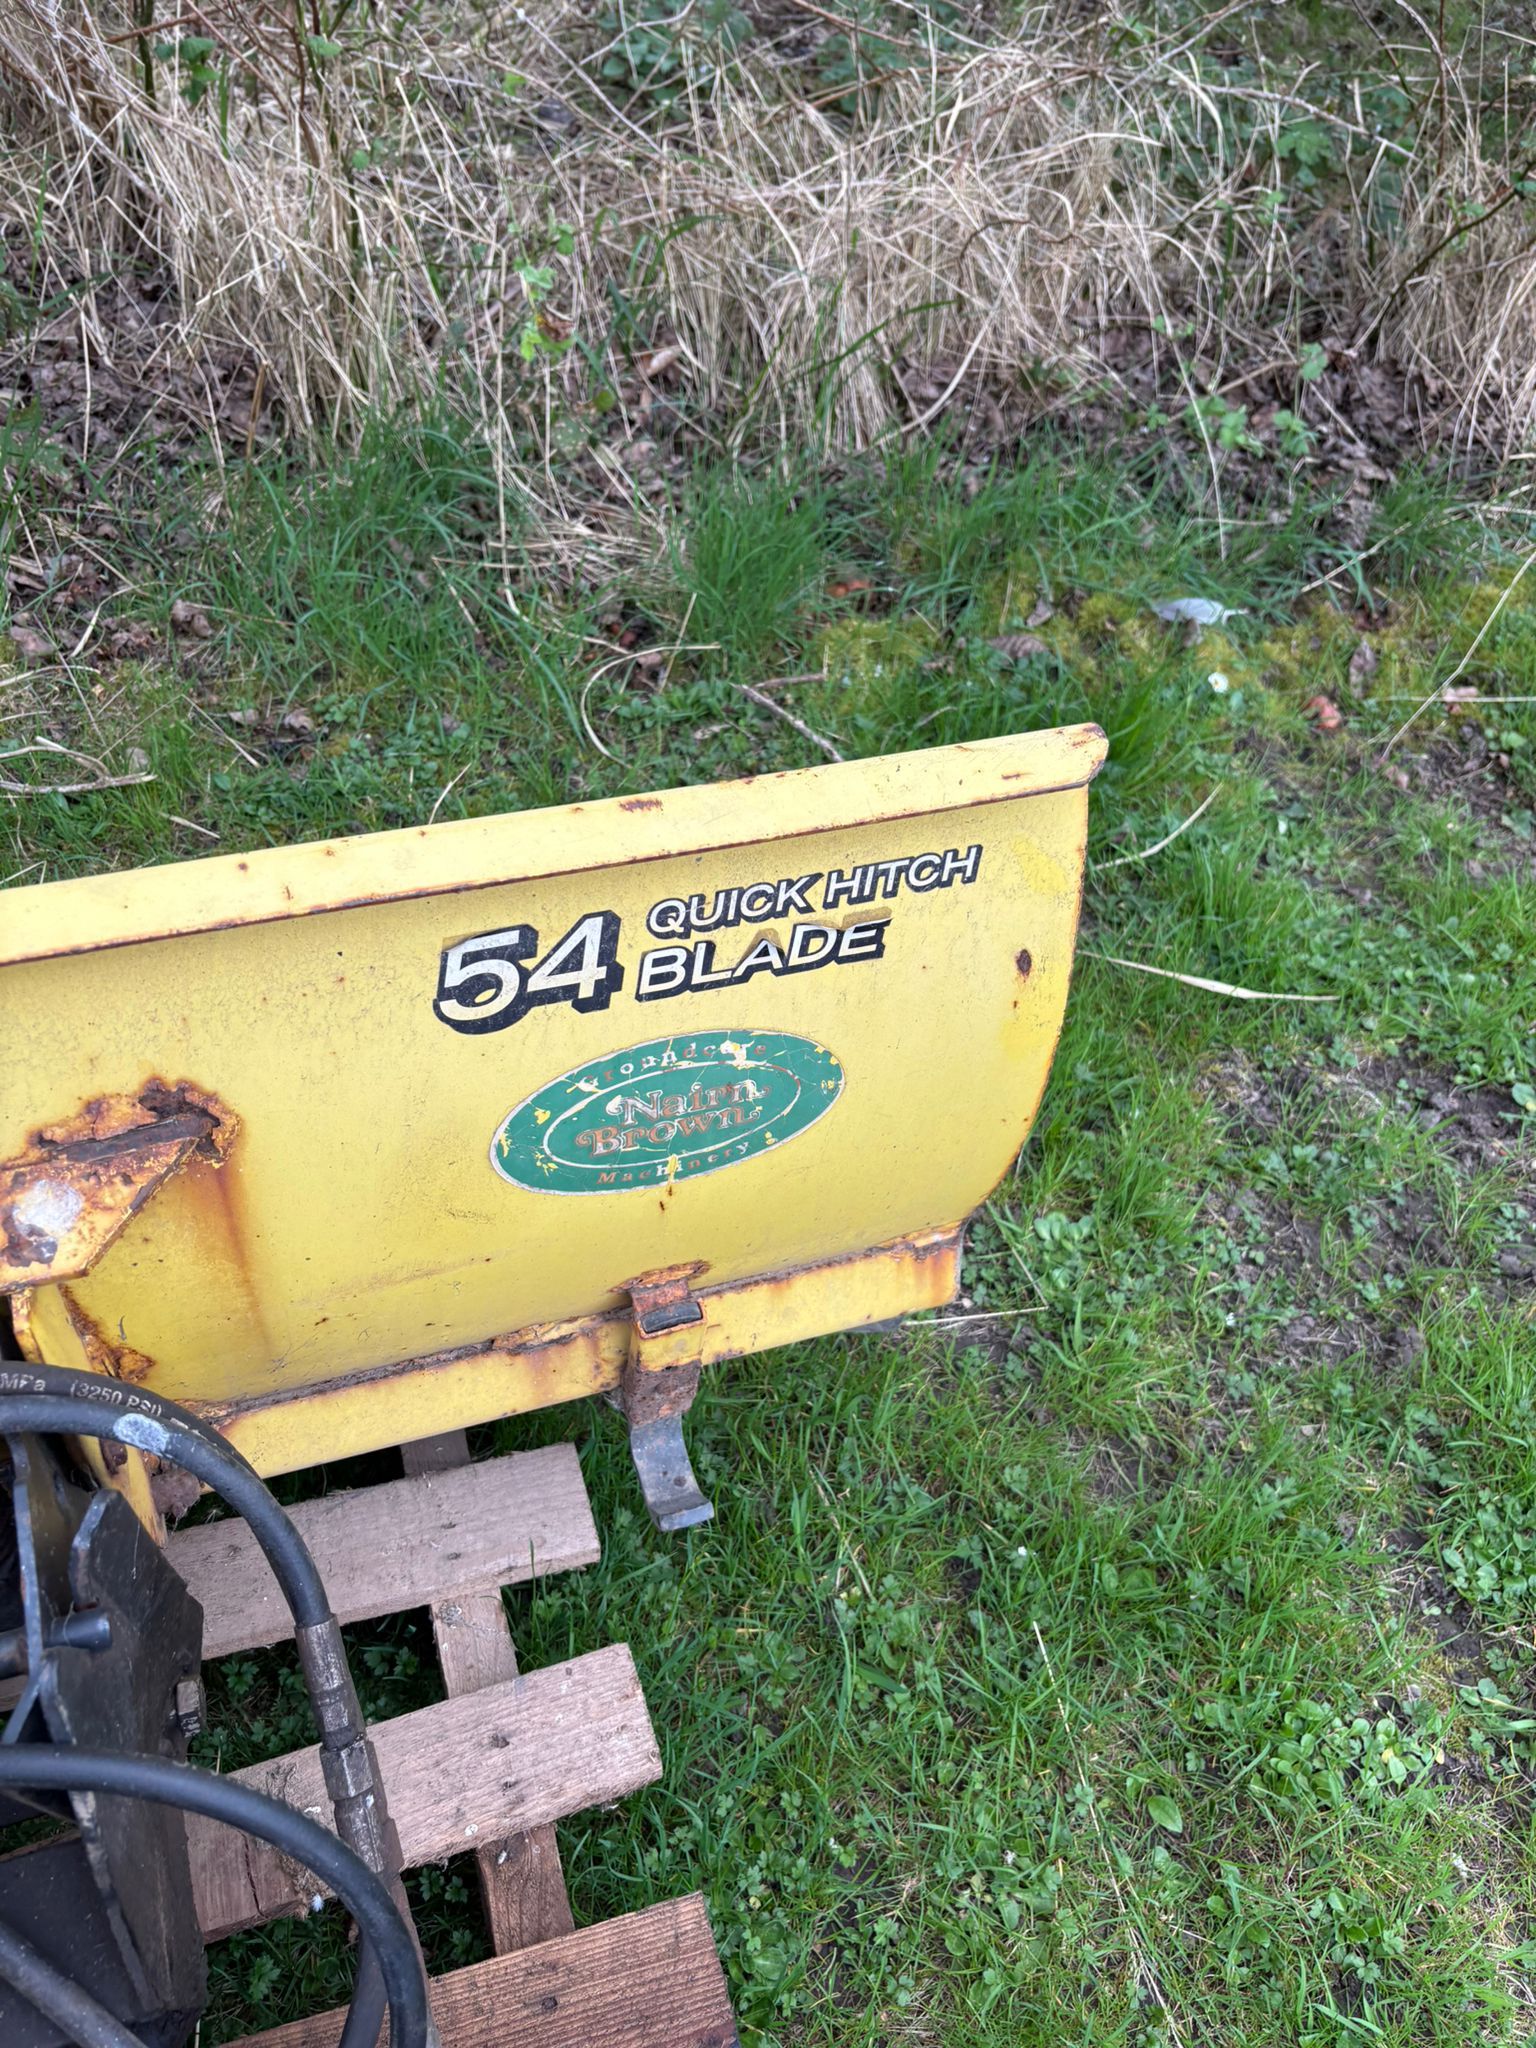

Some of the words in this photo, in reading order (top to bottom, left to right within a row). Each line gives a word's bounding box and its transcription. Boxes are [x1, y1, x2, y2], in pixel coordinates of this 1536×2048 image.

[645, 872, 824, 940] QUICK
[823, 844, 983, 908] HITCH
[433, 909, 622, 1035] 54
[635, 916, 893, 1003] BLADE
[576, 1039, 767, 1092] roundce
[605, 1079, 770, 1126] Nairn
[575, 1105, 761, 1158] Brown
[597, 1141, 750, 1185] Machinery
[70, 1379, 123, 1404] (3250
